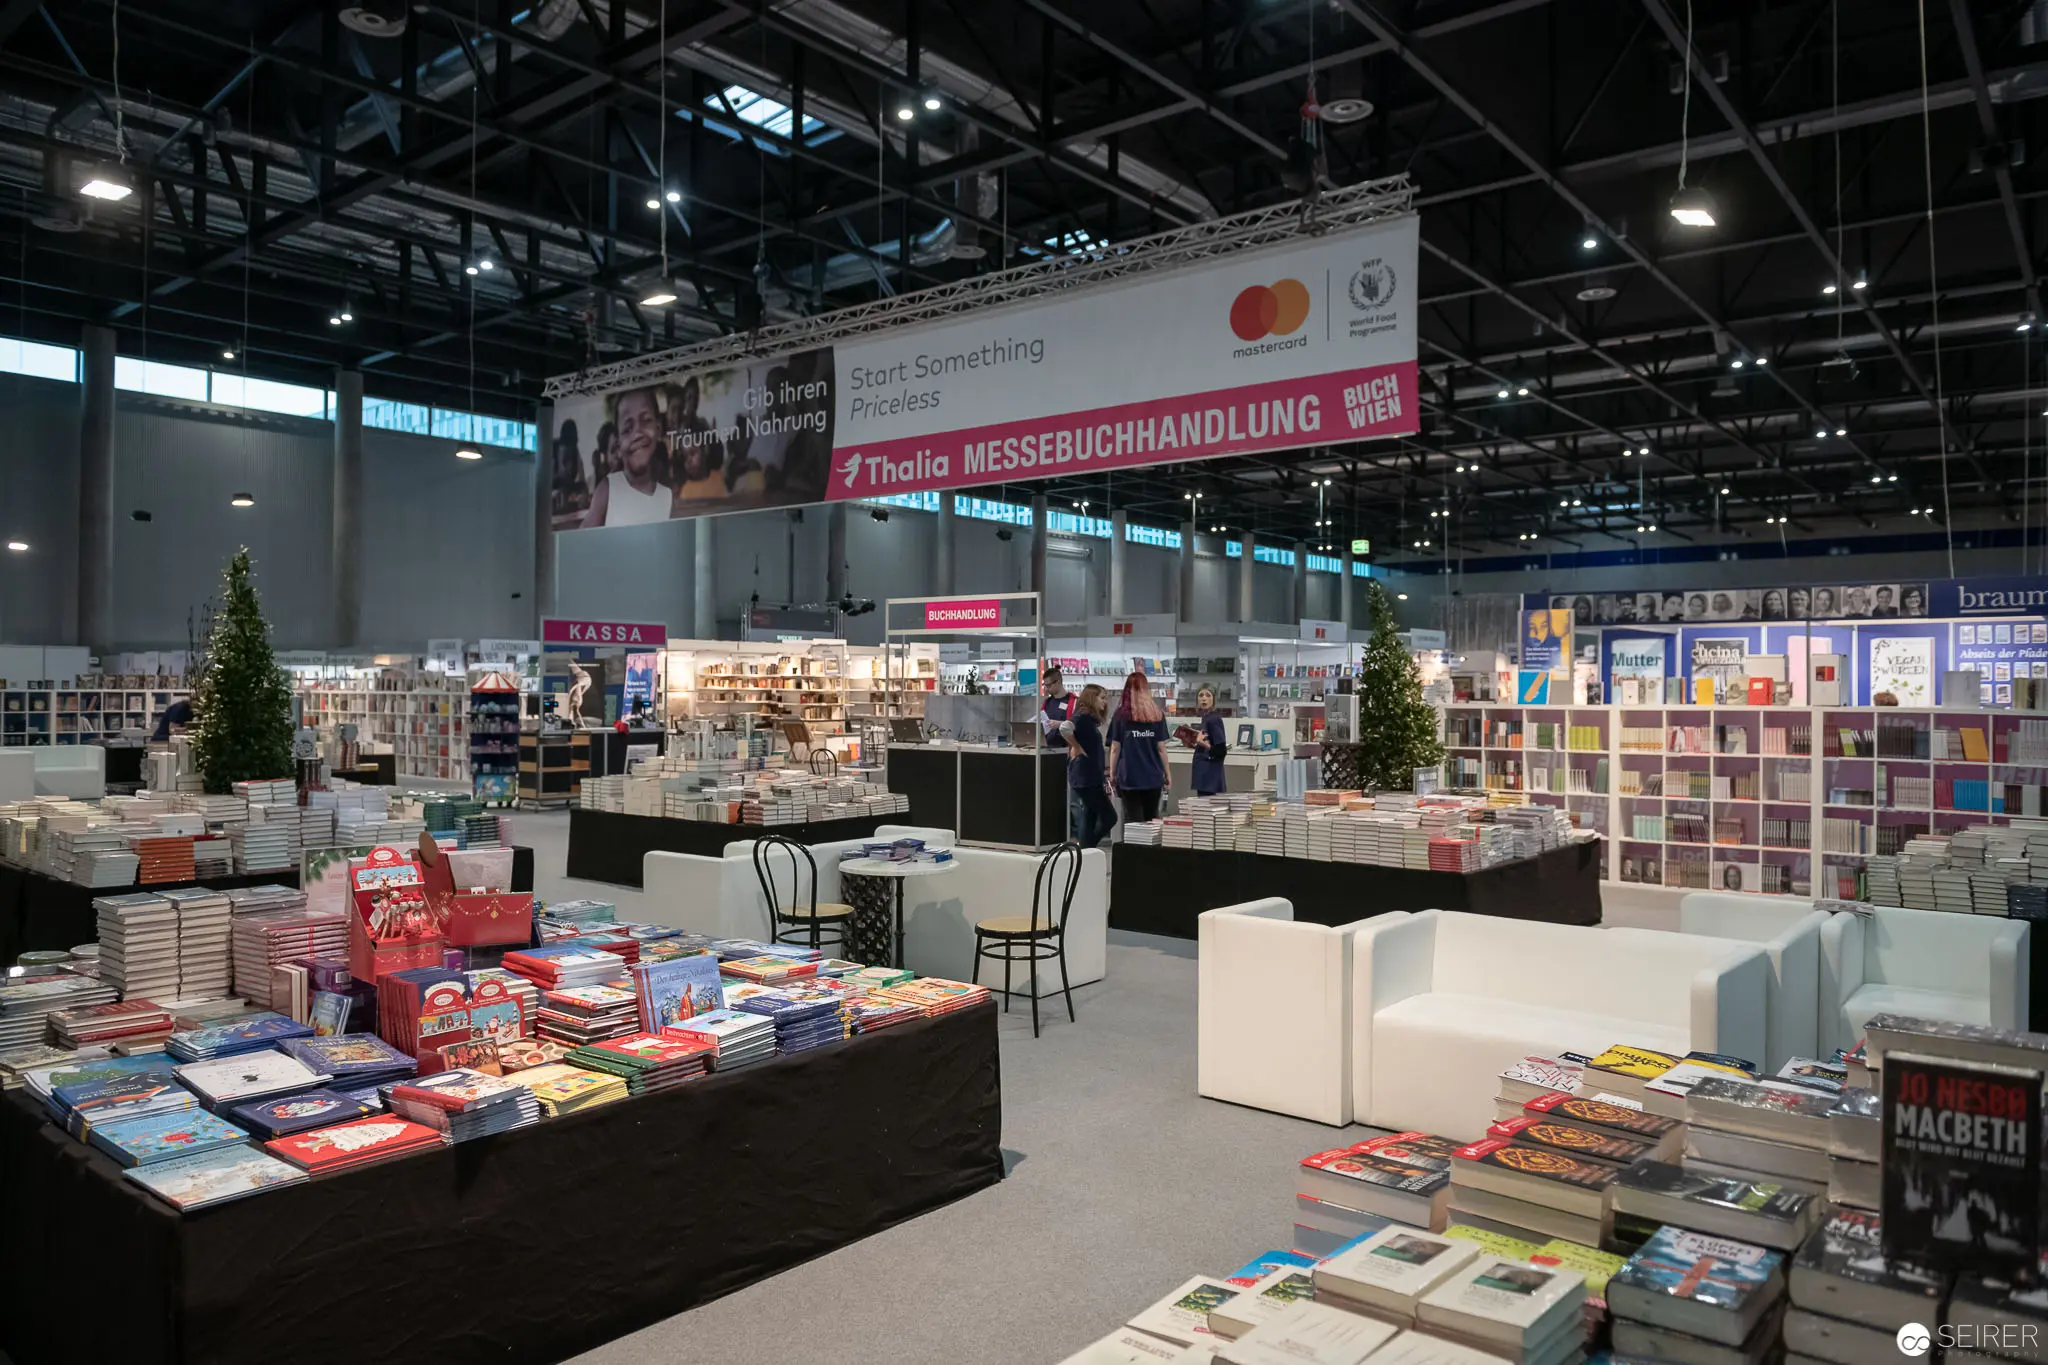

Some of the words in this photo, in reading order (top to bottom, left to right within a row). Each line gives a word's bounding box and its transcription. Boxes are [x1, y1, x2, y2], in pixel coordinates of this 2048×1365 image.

[1361, 258, 1382, 270] WFP
[1349, 315, 1373, 328] World
[1375, 312, 1396, 323] Food
[1349, 323, 1396, 337] Programme
[1233, 335, 1308, 359] mastercard
[850, 361, 907, 390] Start
[914, 337, 1044, 379] Something
[743, 386, 774, 410] Gib
[780, 380, 827, 404] ihren
[1343, 373, 1399, 409] BUCH
[850, 389, 941, 421] Priceless
[1347, 396, 1402, 429] WIEN
[666, 424, 740, 452] Träumen
[746, 410, 827, 438] Nahrung
[865, 449, 949, 486] Thalia
[964, 394, 1320, 475] MESSEBUCHHANDLUNG
[928, 608, 996, 621] BUCHHANDLUNG
[569, 624, 642, 641] KASSA
[1612, 652, 1662, 667] Mutter
[1960, 648, 1996, 659] Abseits
[1998, 648, 2016, 658] der
[2019, 647, 2048, 658] Pfade
[1132, 730, 1155, 738] Thalia
[1897, 1071, 1929, 1105] JO
[1895, 1102, 2027, 1155] MACBETH
